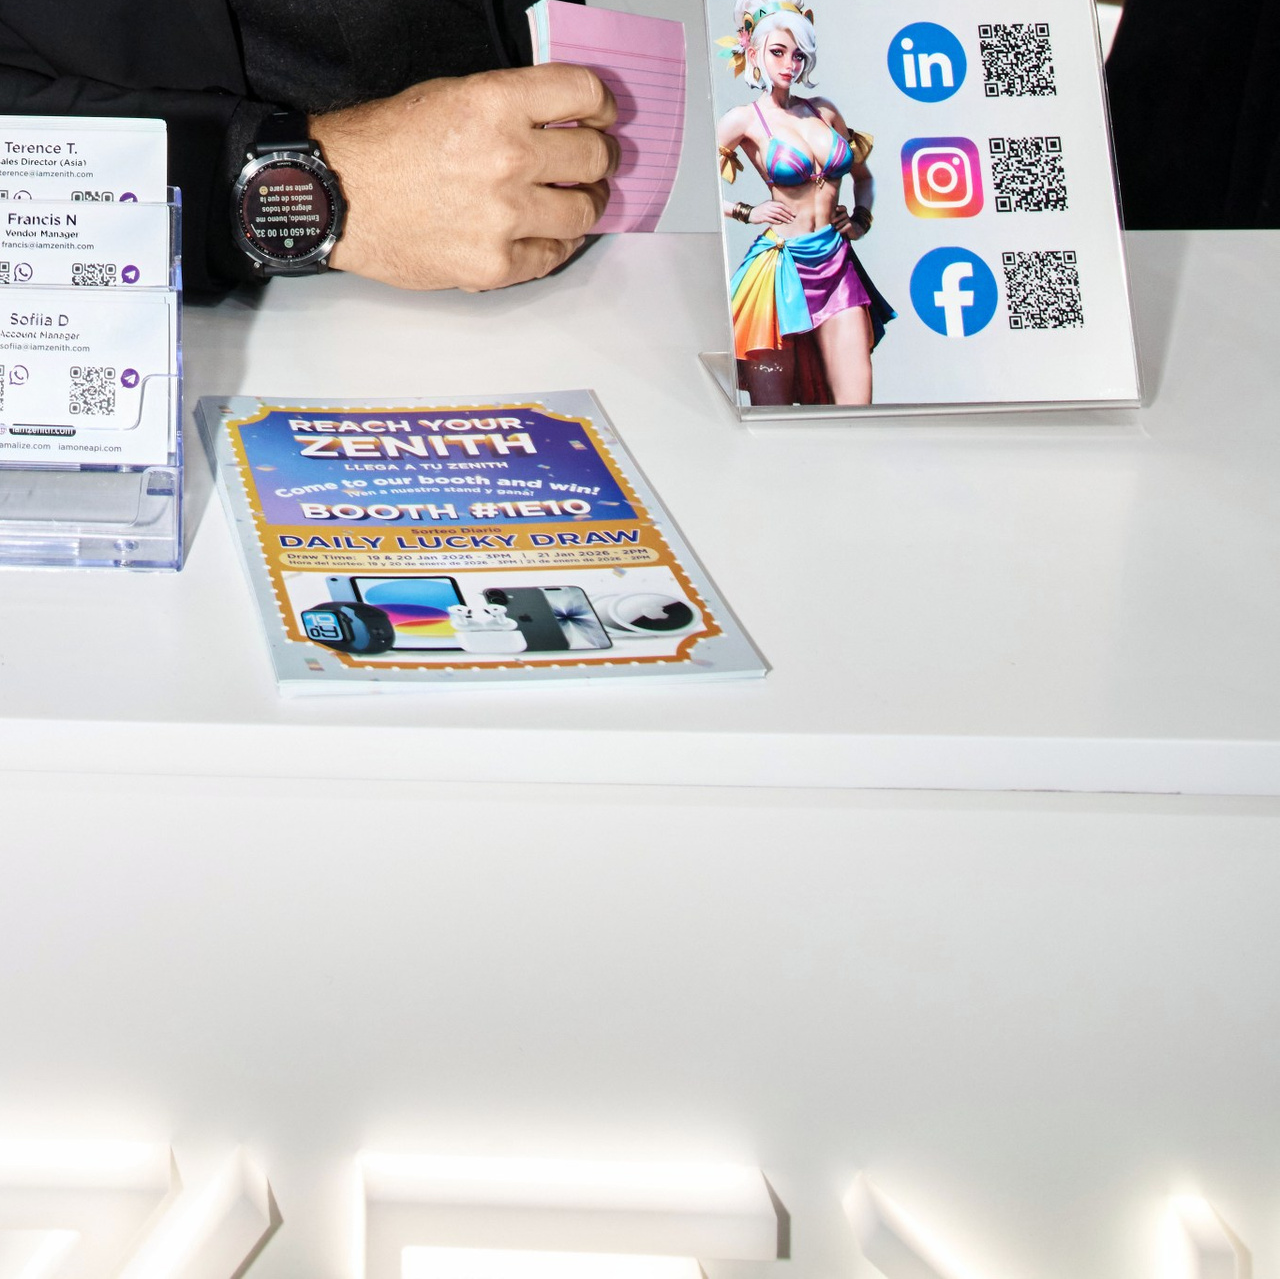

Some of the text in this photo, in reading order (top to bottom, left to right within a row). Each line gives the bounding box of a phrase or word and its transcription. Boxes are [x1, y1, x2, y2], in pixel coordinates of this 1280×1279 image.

[5, 141, 78, 154] Terence T.
[21, 157, 57, 167] Director
[60, 158, 87, 168] (Asia)
[0, 169, 94, 179] terence@iamzenith.com
[269, 184, 284, 192] pare
[294, 183, 313, 192] gente
[267, 194, 281, 202] que
[281, 195, 290, 203] de
[291, 194, 313, 203] modos
[262, 205, 281, 213] todos
[291, 204, 312, 213] alegro
[8, 212, 77, 226] Francis N
[268, 215, 288, 224] bueno
[288, 214, 320, 223] Entiendo,
[5, 229, 79, 240] Vendor Manager
[1, 240, 95, 251] francis@iamzenith.com
[10, 312, 69, 327] Sofiia D
[0, 329, 80, 341] Account Manager
[0, 342, 91, 352] sofiia@iamzenith.com
[288, 417, 525, 433] REACH YOUR
[58, 442, 123, 453] iamoneapi.com
[293, 432, 538, 459] ZENITH
[344, 461, 509, 471] LLEGA A TU ZENITH
[275, 474, 601, 498] Come to our booth and win!
[391, 485, 441, 495] nuestro
[444, 484, 483, 494] stand
[301, 498, 592, 520] BOOTH #1E10
[461, 526, 502, 534] Diario
[278, 528, 640, 550] DAILY LUCKY DRAW
[323, 553, 356, 561] Time:
[441, 552, 473, 561] 2026
[485, 552, 512, 560] 3PM
[554, 550, 575, 558] Jan
